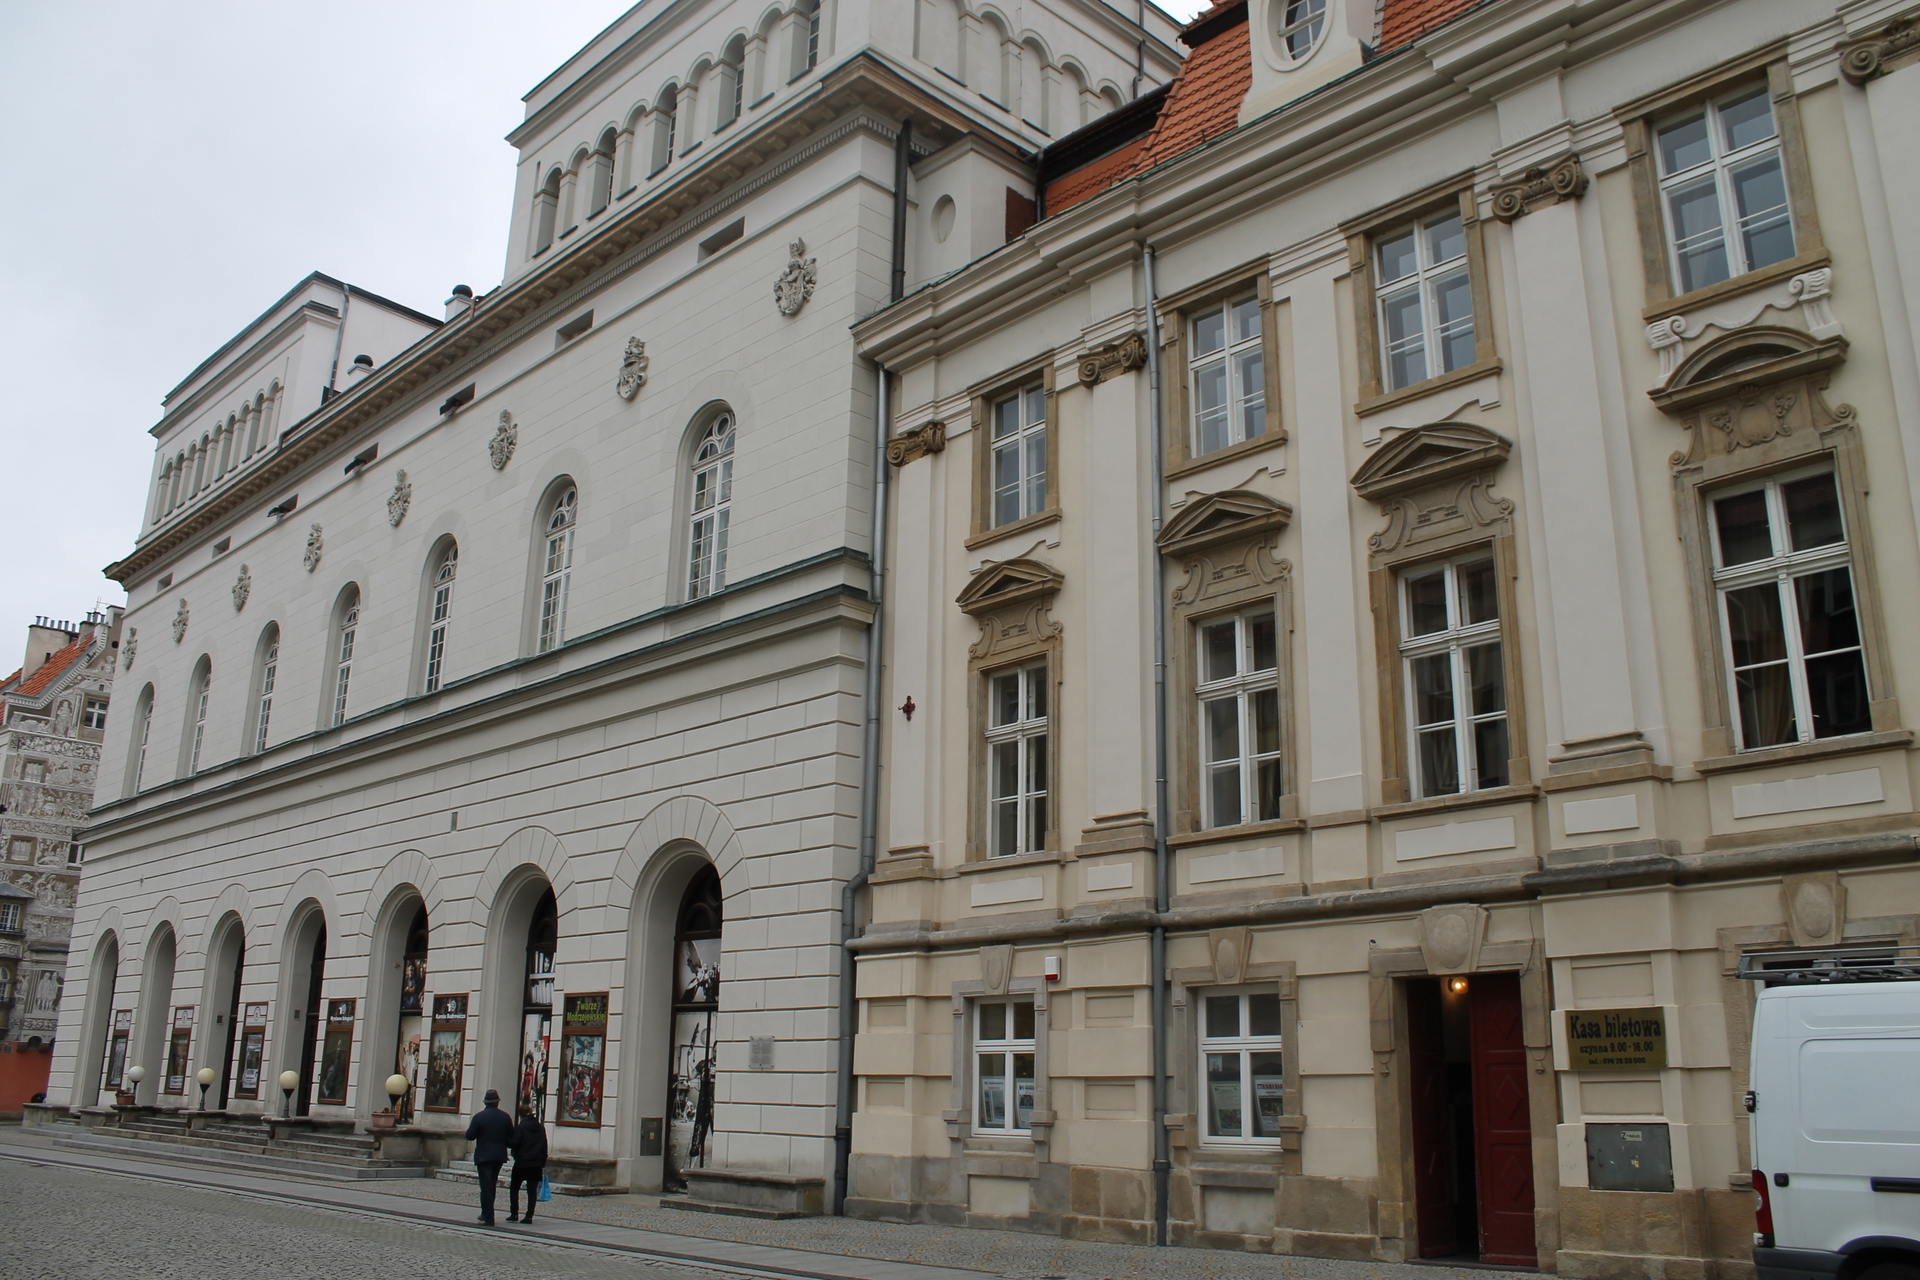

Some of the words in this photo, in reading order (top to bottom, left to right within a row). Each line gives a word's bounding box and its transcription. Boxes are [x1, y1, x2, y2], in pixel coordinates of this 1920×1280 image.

[577, 1001, 597, 1010] Twarze
[1570, 1015, 1601, 1039] Kasa
[1605, 1014, 1662, 1038] biletowa
[1580, 1045, 1608, 1055] czynna
[1610, 1042, 1627, 1052] 9.00
[1633, 1041, 1653, 1052] 16.00
